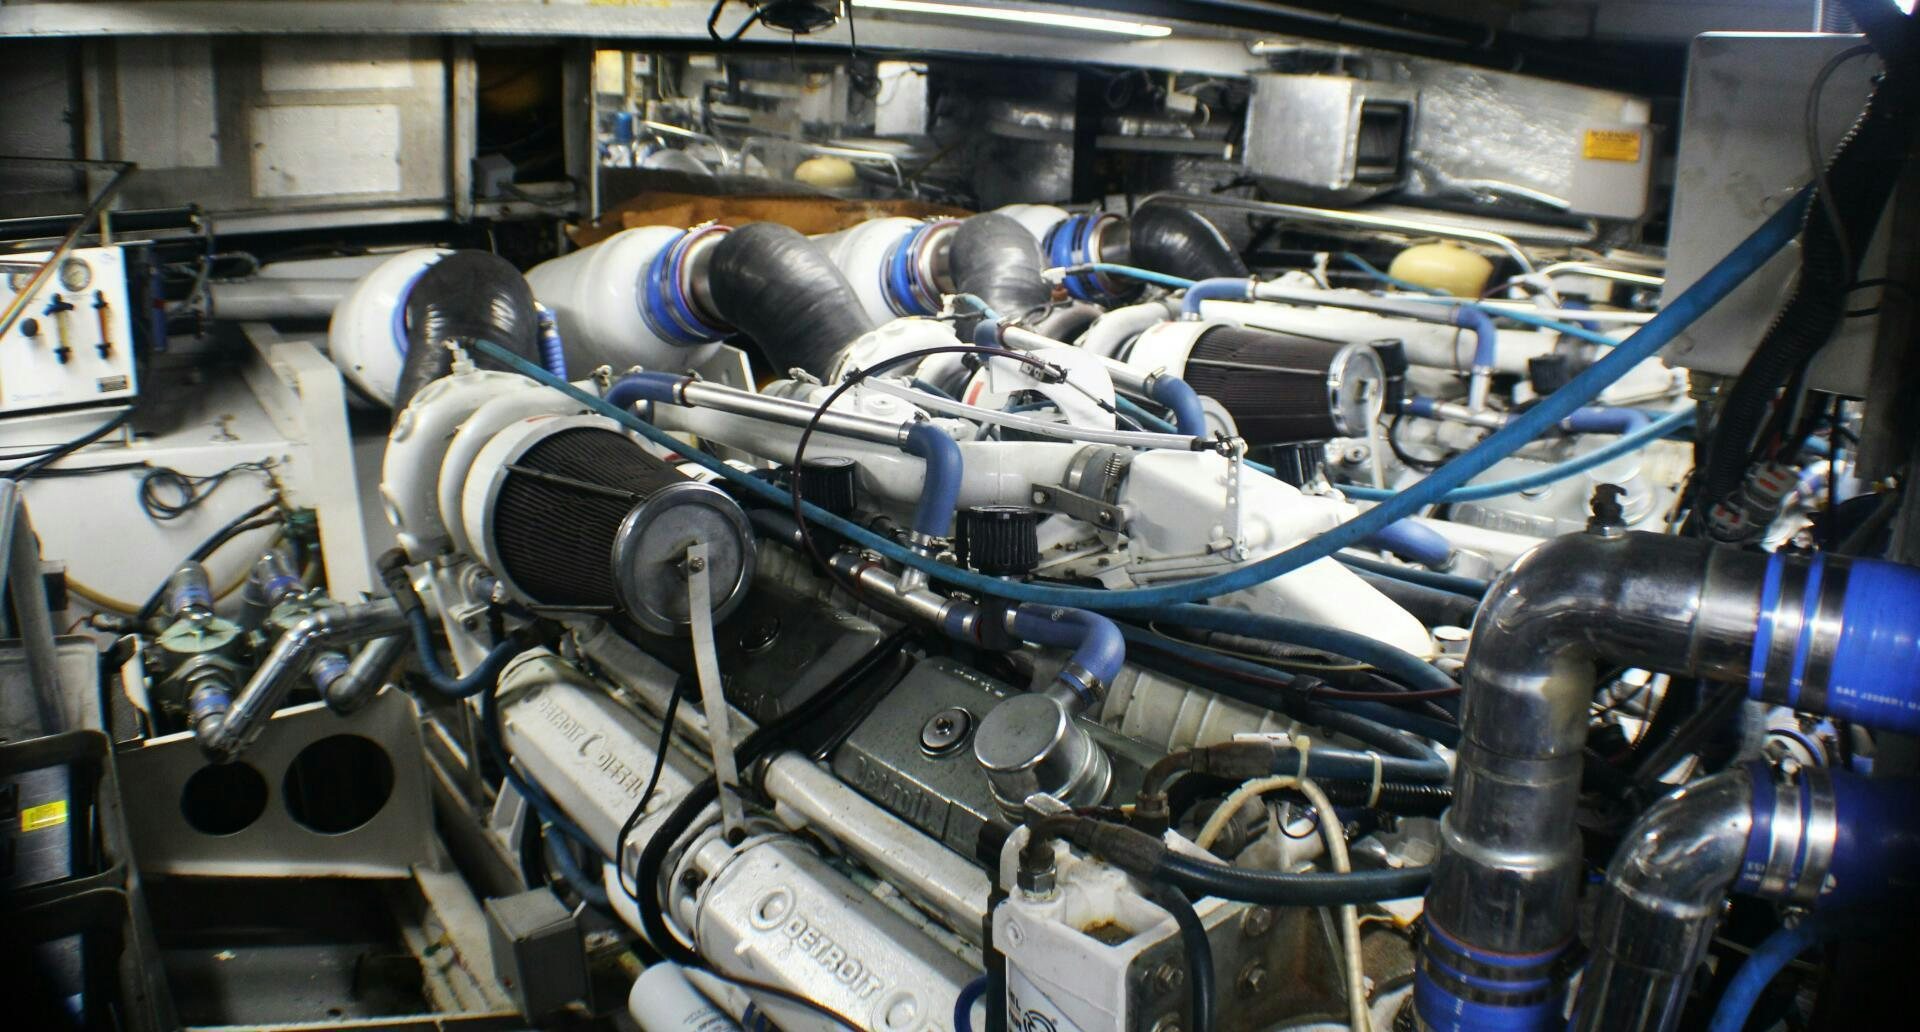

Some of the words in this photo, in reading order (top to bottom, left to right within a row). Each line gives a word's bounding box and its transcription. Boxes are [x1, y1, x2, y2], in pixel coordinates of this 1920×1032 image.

[538, 698, 586, 743] DETROIT
[598, 752, 643, 800] DIESEL
[783, 914, 883, 1000] DETROIT
